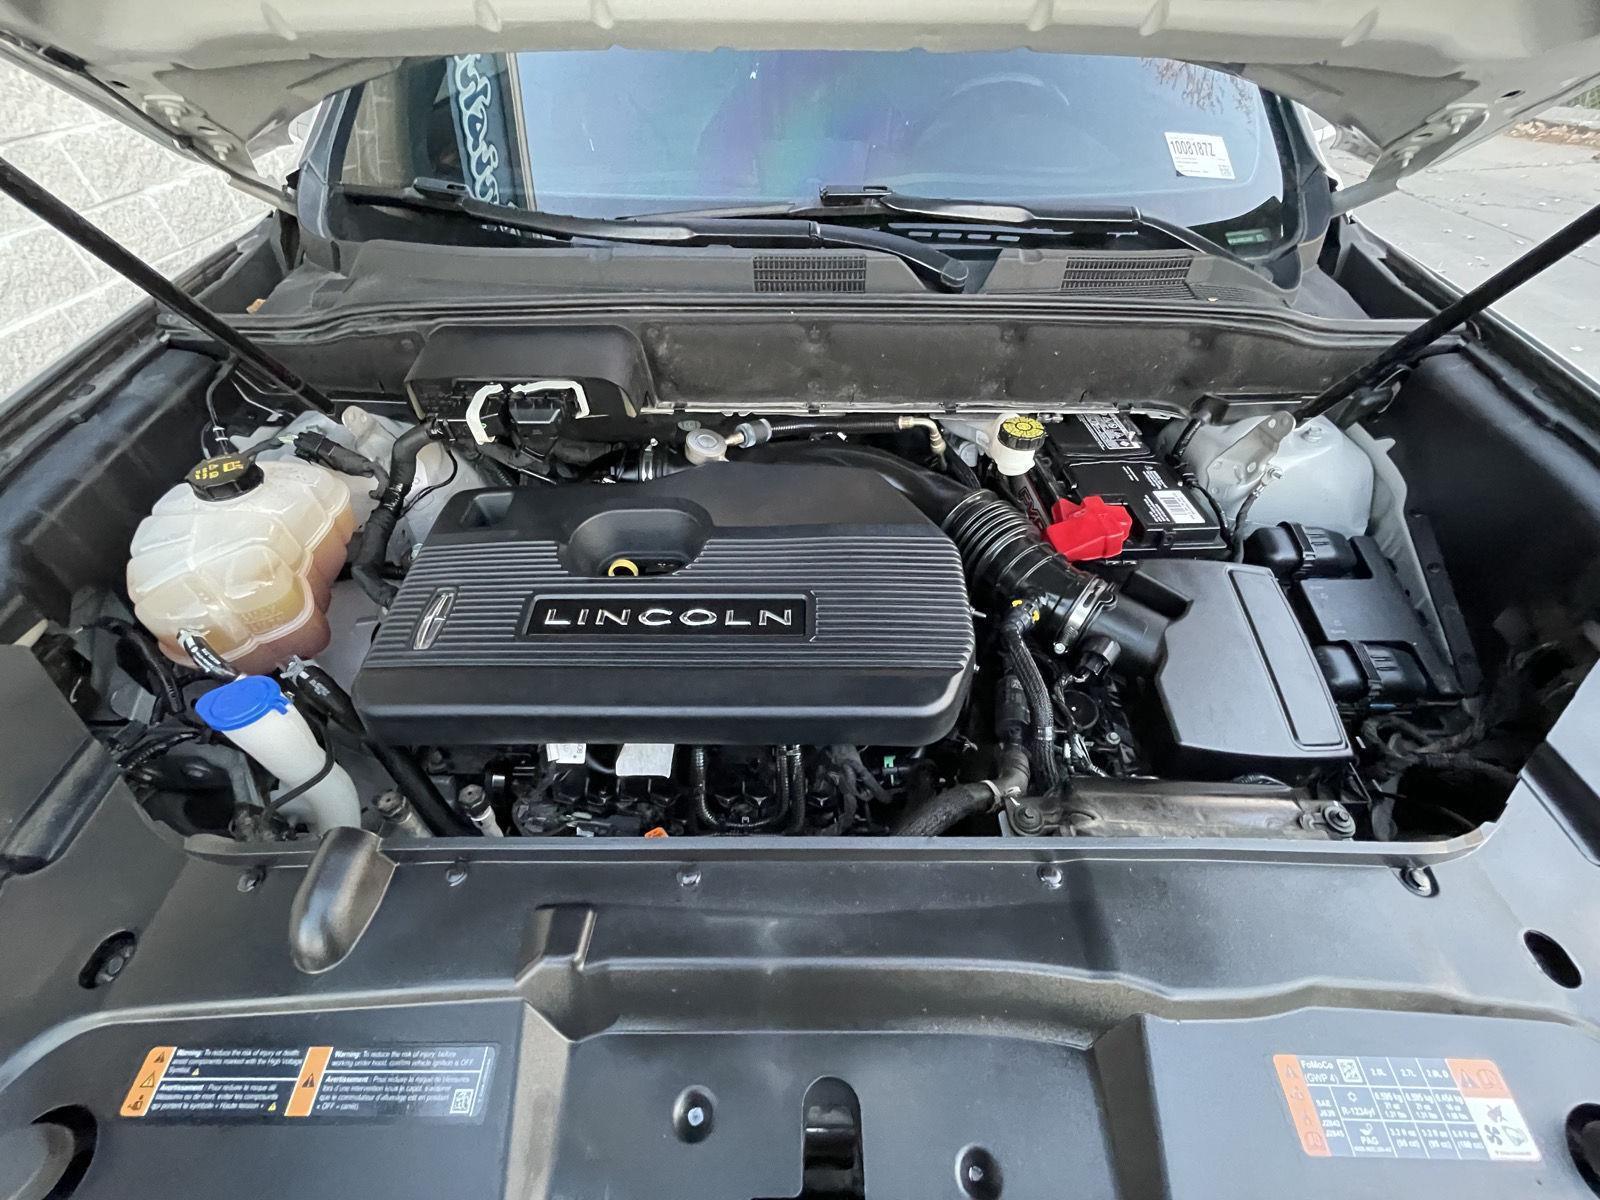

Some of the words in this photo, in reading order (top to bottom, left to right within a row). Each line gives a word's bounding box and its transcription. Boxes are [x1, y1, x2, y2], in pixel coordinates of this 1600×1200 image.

[544, 608, 792, 626] LINCOLN
[1301, 1060, 1334, 1069] FoMoCo
[1305, 1073, 1328, 1084] (GWP
